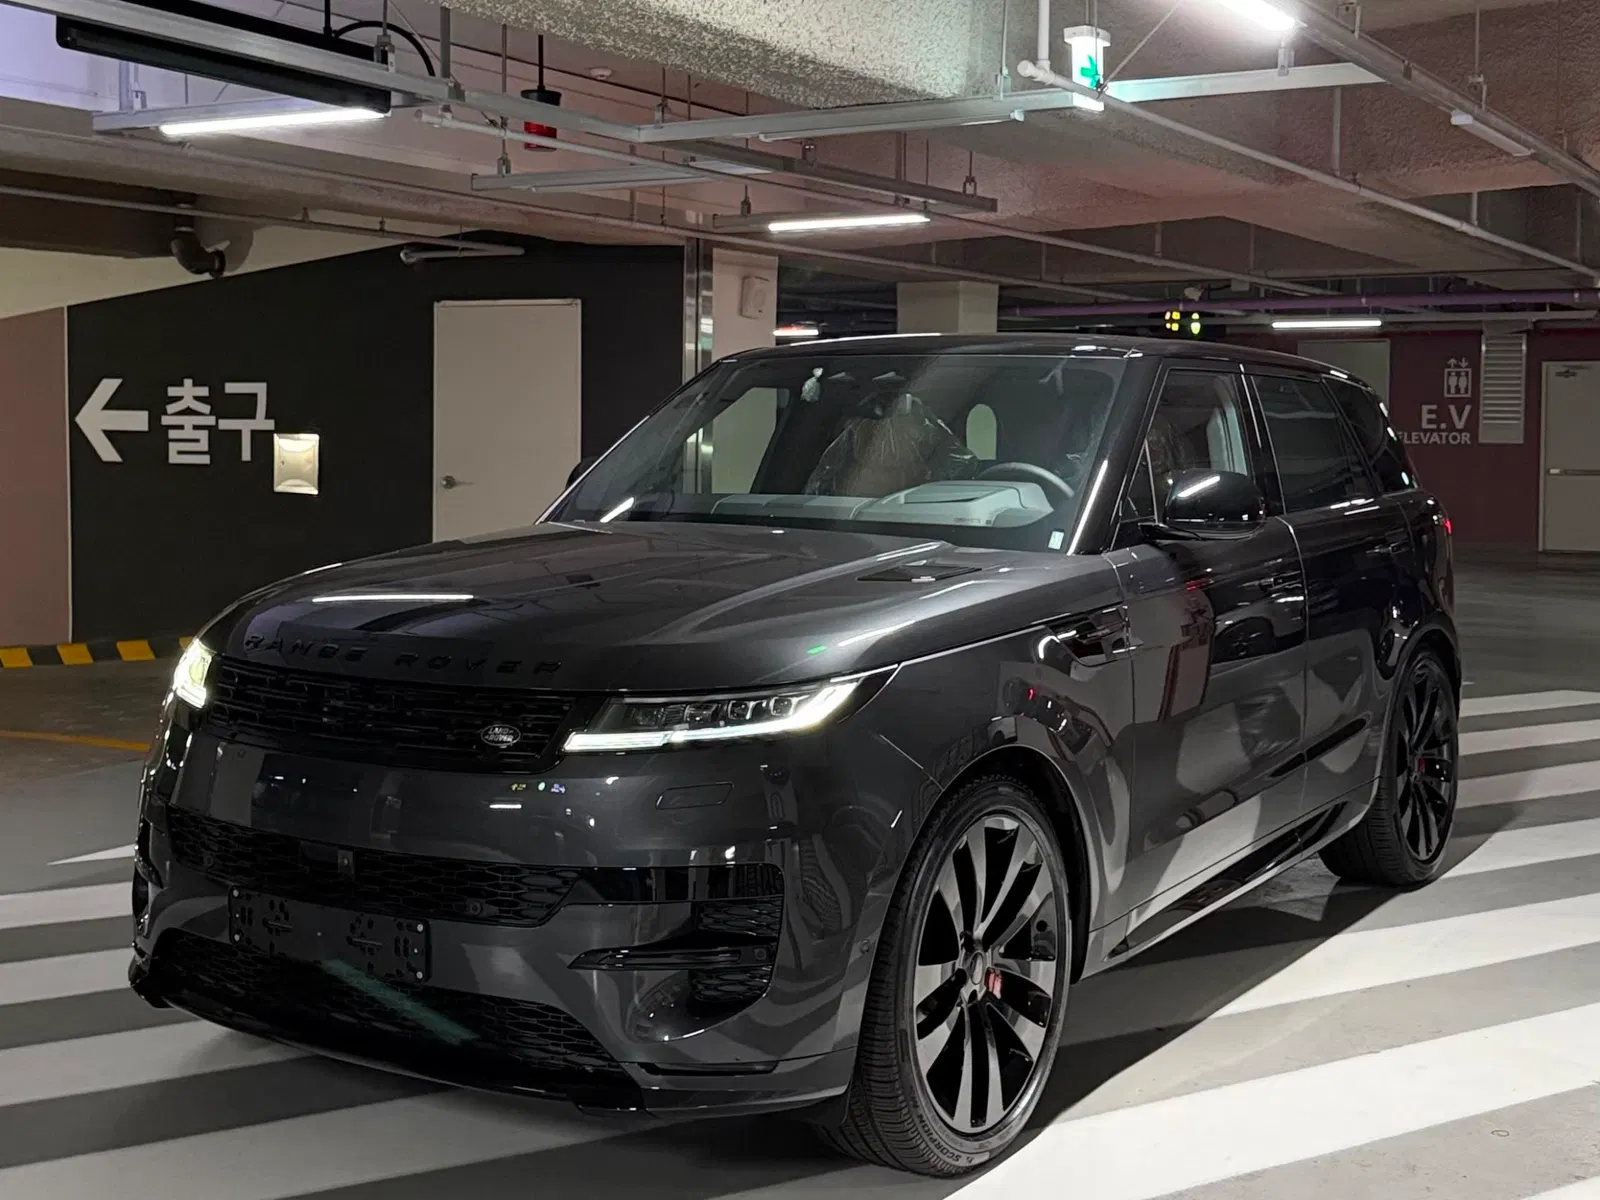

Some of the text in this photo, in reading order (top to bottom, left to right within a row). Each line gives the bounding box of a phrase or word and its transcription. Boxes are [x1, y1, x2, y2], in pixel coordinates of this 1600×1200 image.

[161, 378, 275, 464] 출구
[1421, 404, 1472, 429] E.V
[245, 635, 564, 676] RANGE ROVER
[916, 1113, 962, 1162] SCORPION
